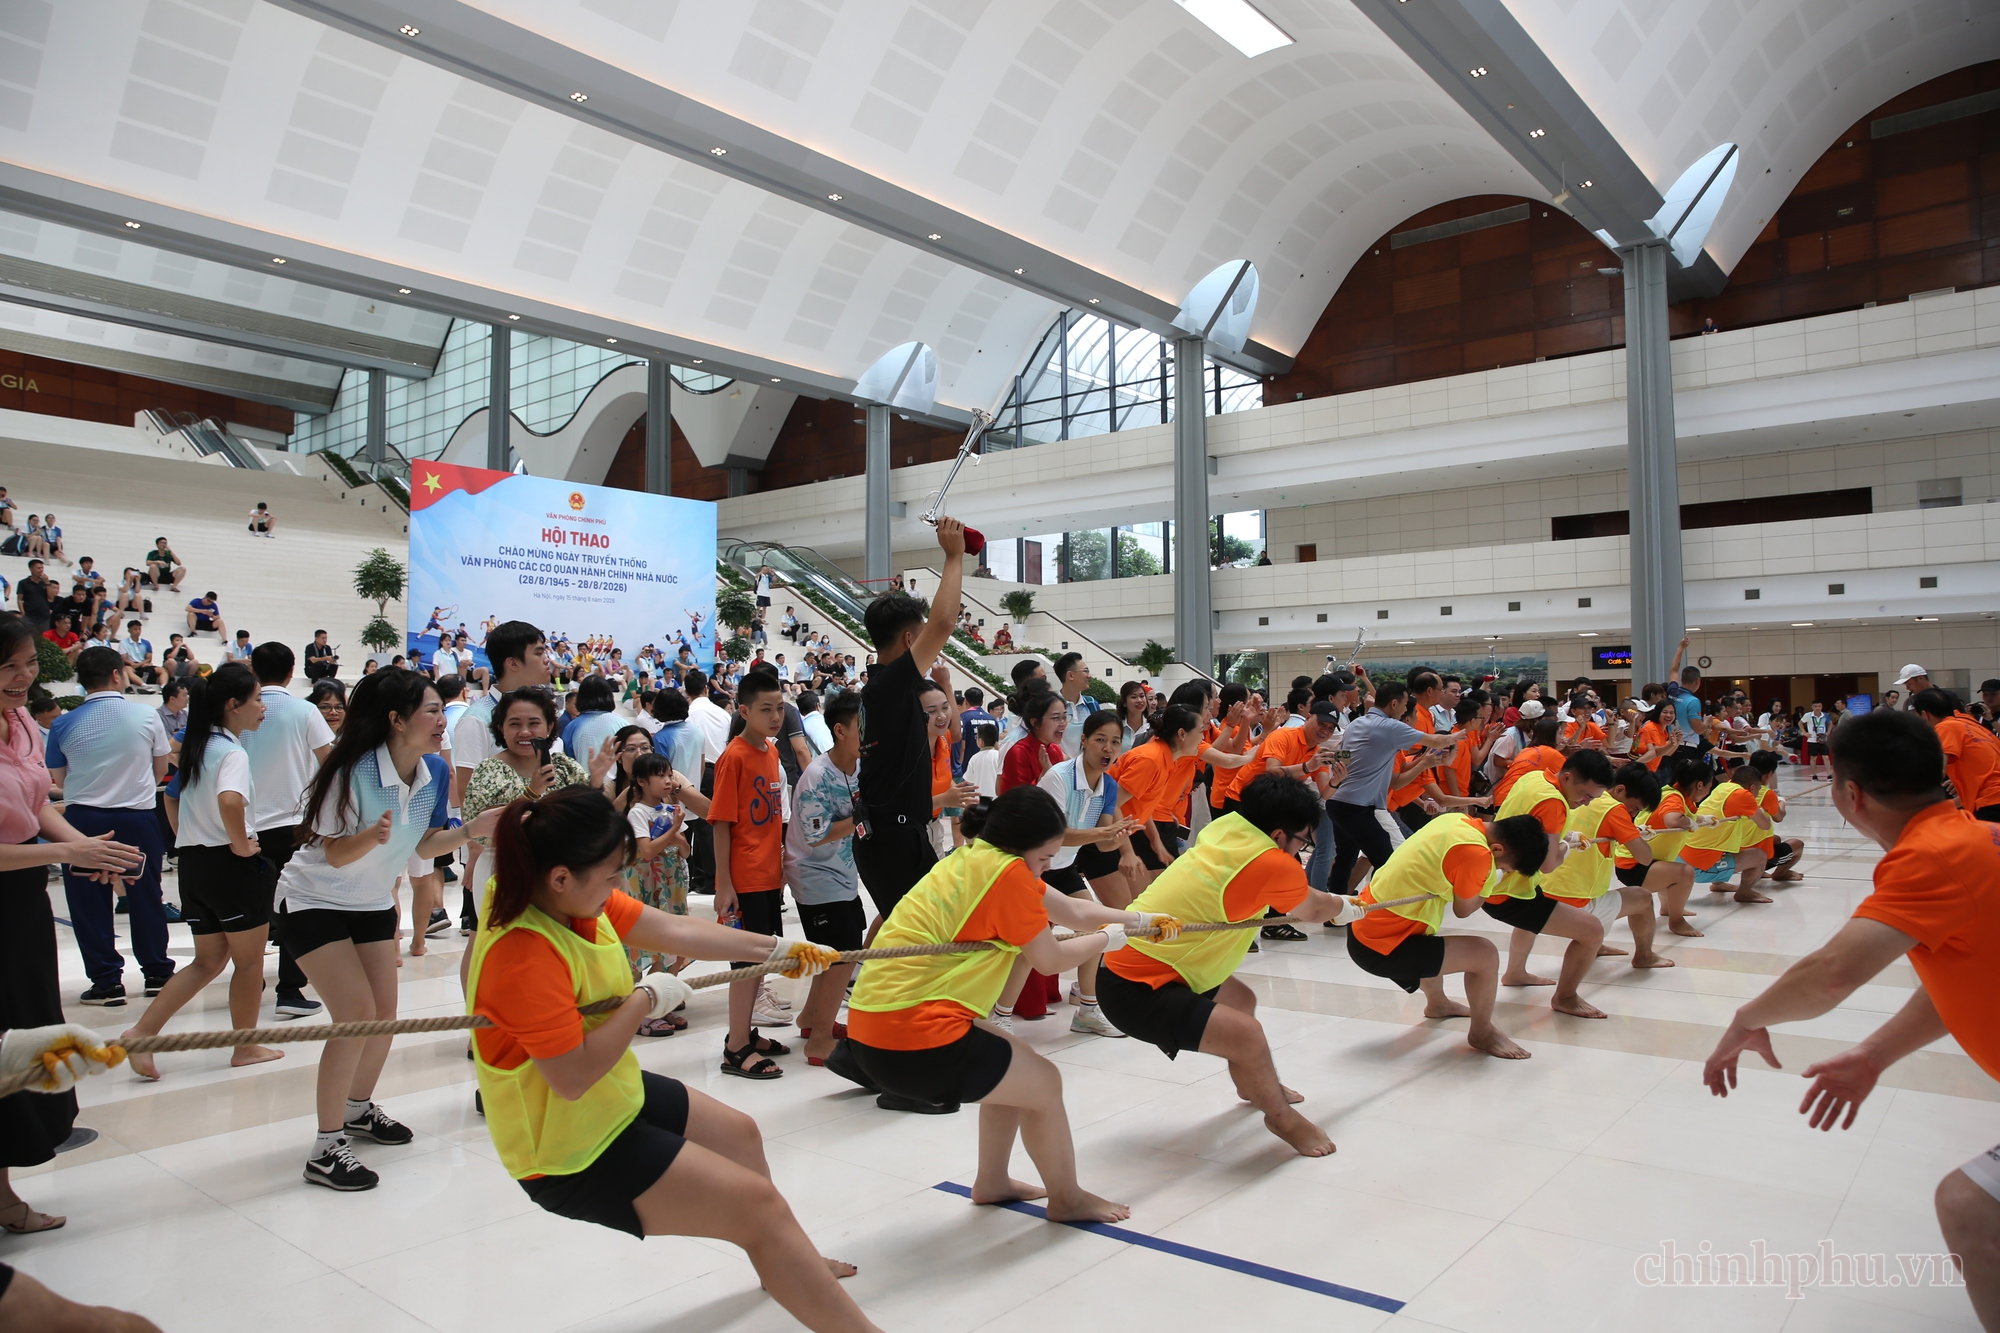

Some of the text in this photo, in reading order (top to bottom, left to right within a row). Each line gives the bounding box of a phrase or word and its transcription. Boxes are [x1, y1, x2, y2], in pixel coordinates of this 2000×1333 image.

[0, 374, 40, 393] GIA
[541, 526, 610, 549] HỘI THAO
[499, 545, 525, 557] CHÀO
[527, 547, 554, 560] MỪNG
[556, 551, 580, 562] NGÀY
[618, 557, 648, 569] THỐNG
[460, 554, 678, 584] VĂN PHÒNG CÁC CƠ QUAN HÀNH CHÍNH NHÀ NƯỚC
[518, 574, 570, 587] (28/8/1945
[577, 579, 628, 593] 28/8/2026)
